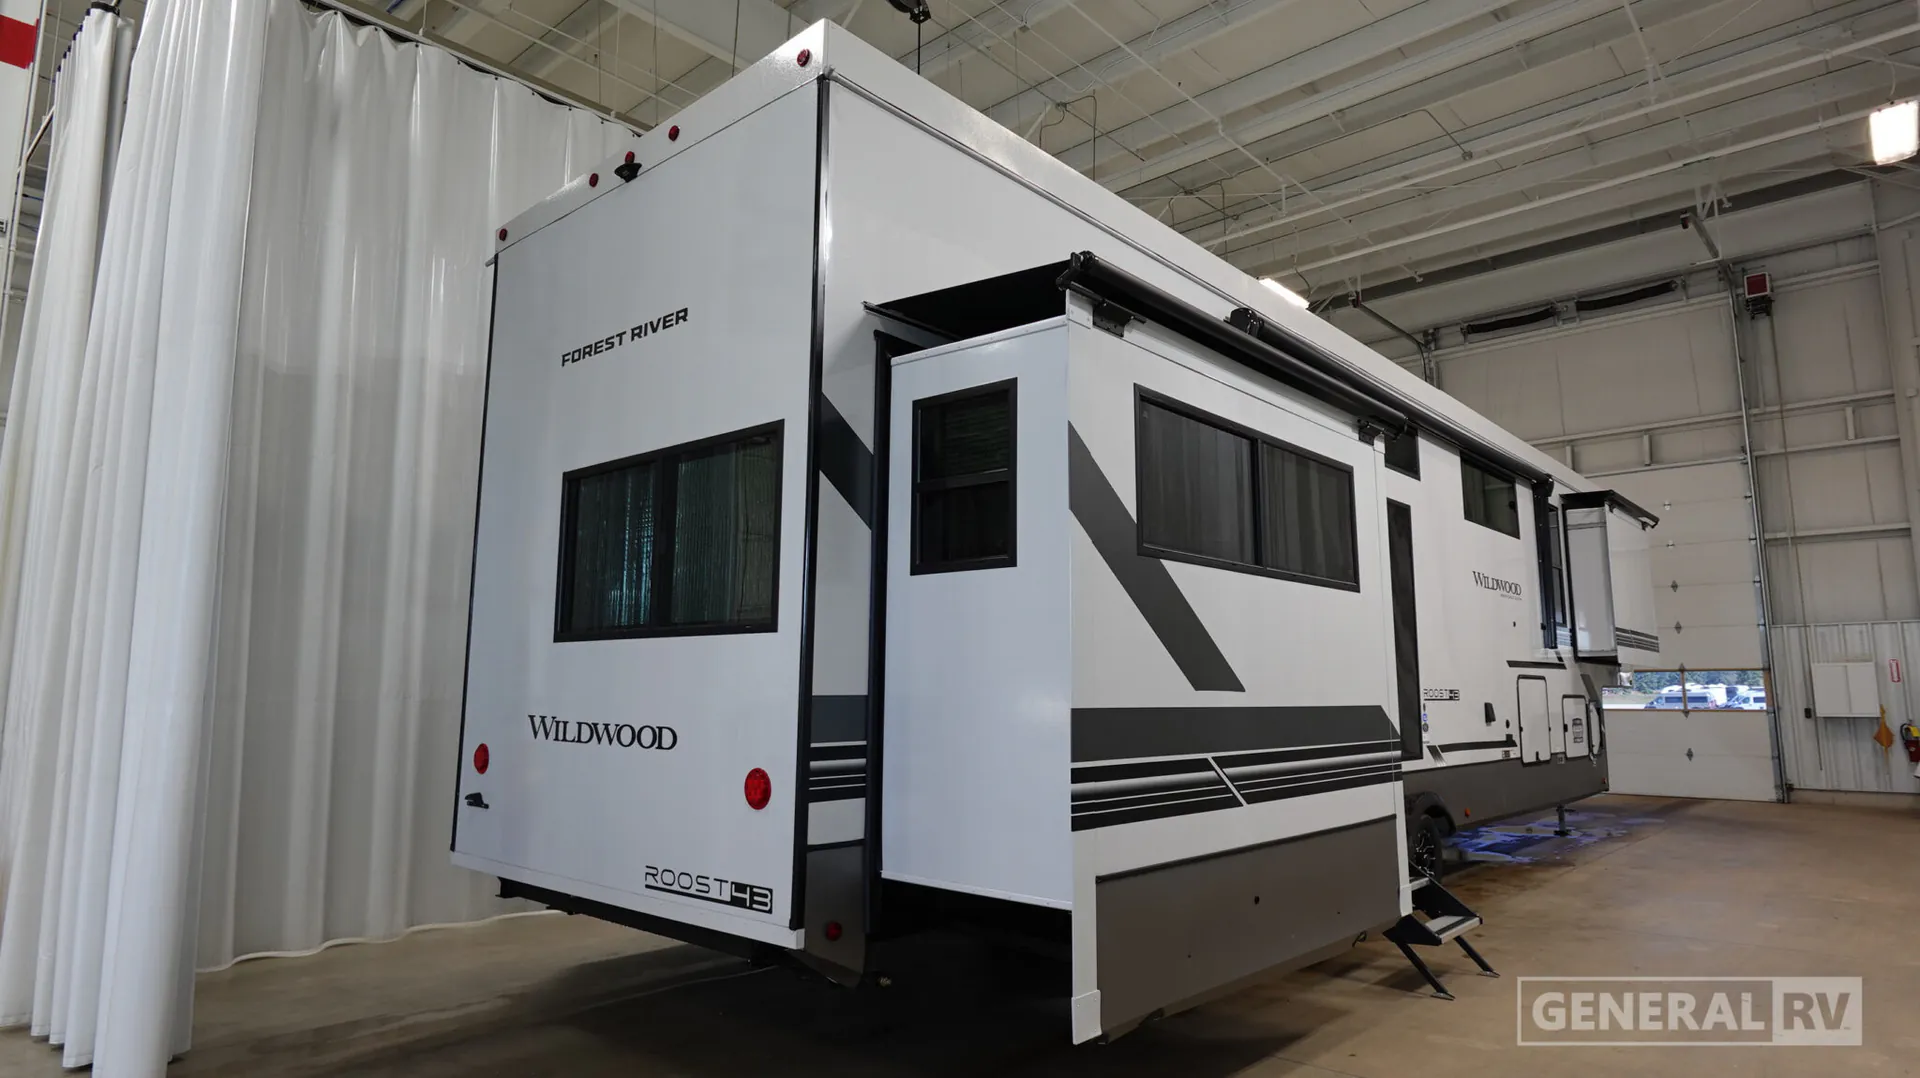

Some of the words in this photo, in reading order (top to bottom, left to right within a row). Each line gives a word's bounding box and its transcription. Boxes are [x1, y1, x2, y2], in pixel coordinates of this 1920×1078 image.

[561, 331, 627, 368] FOREST
[630, 307, 688, 342] RIVER
[1472, 570, 1522, 596] WILDWOOD
[527, 714, 678, 751] WILDWOOD
